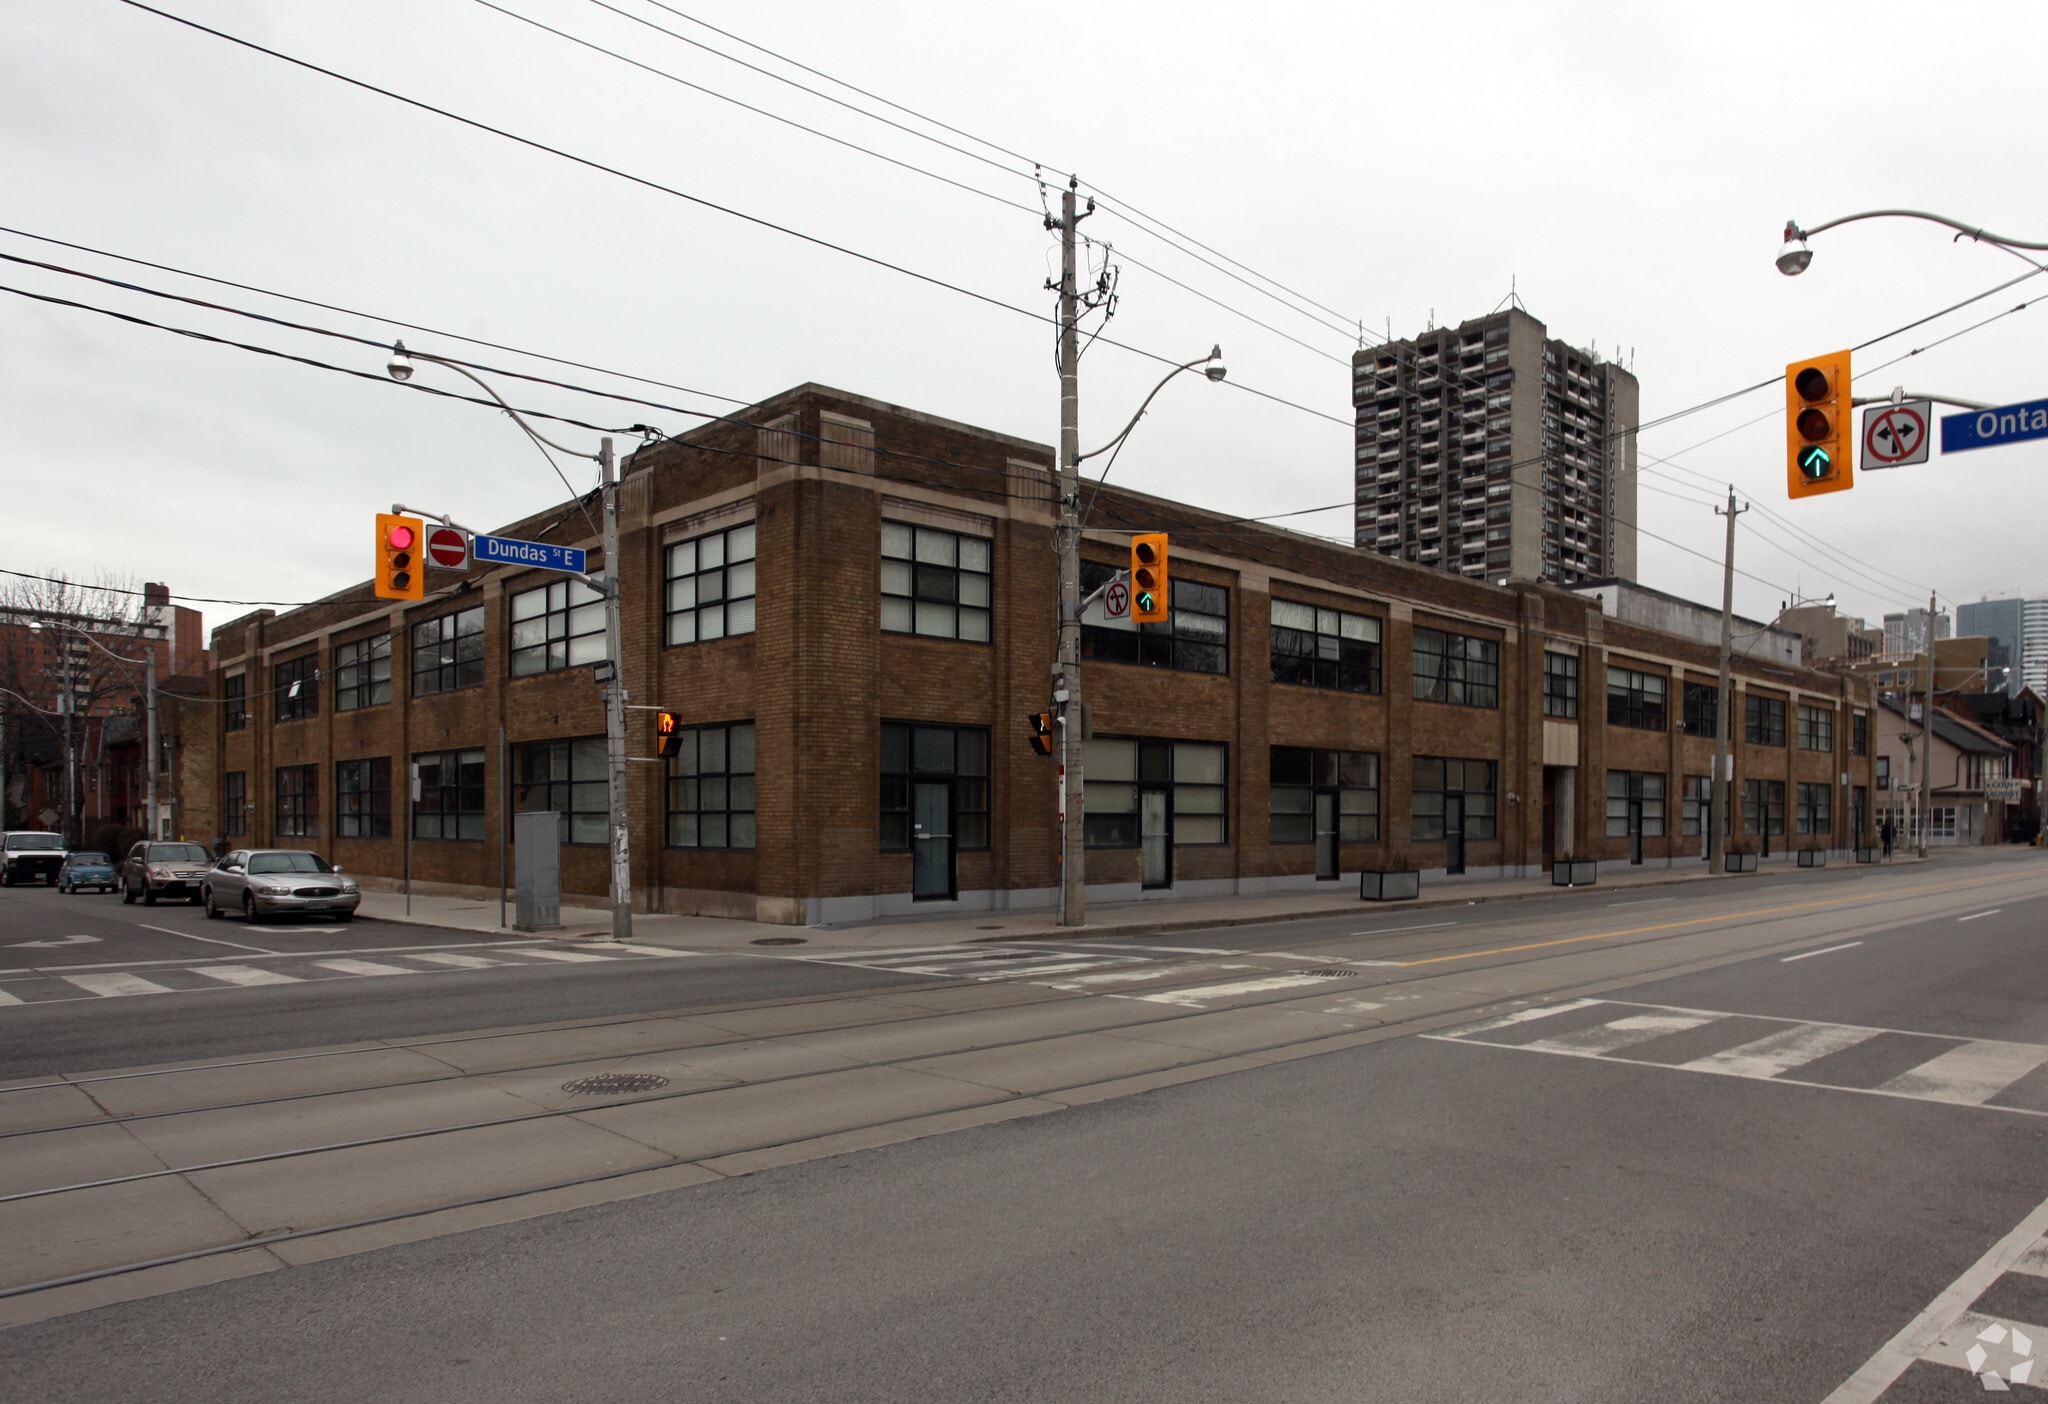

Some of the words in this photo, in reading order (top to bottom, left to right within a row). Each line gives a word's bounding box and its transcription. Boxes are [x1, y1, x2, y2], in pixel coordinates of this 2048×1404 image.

[1976, 407, 2048, 438] Onta
[488, 539, 547, 562] Dundas
[553, 548, 561, 557] St
[564, 550, 573, 566] E
